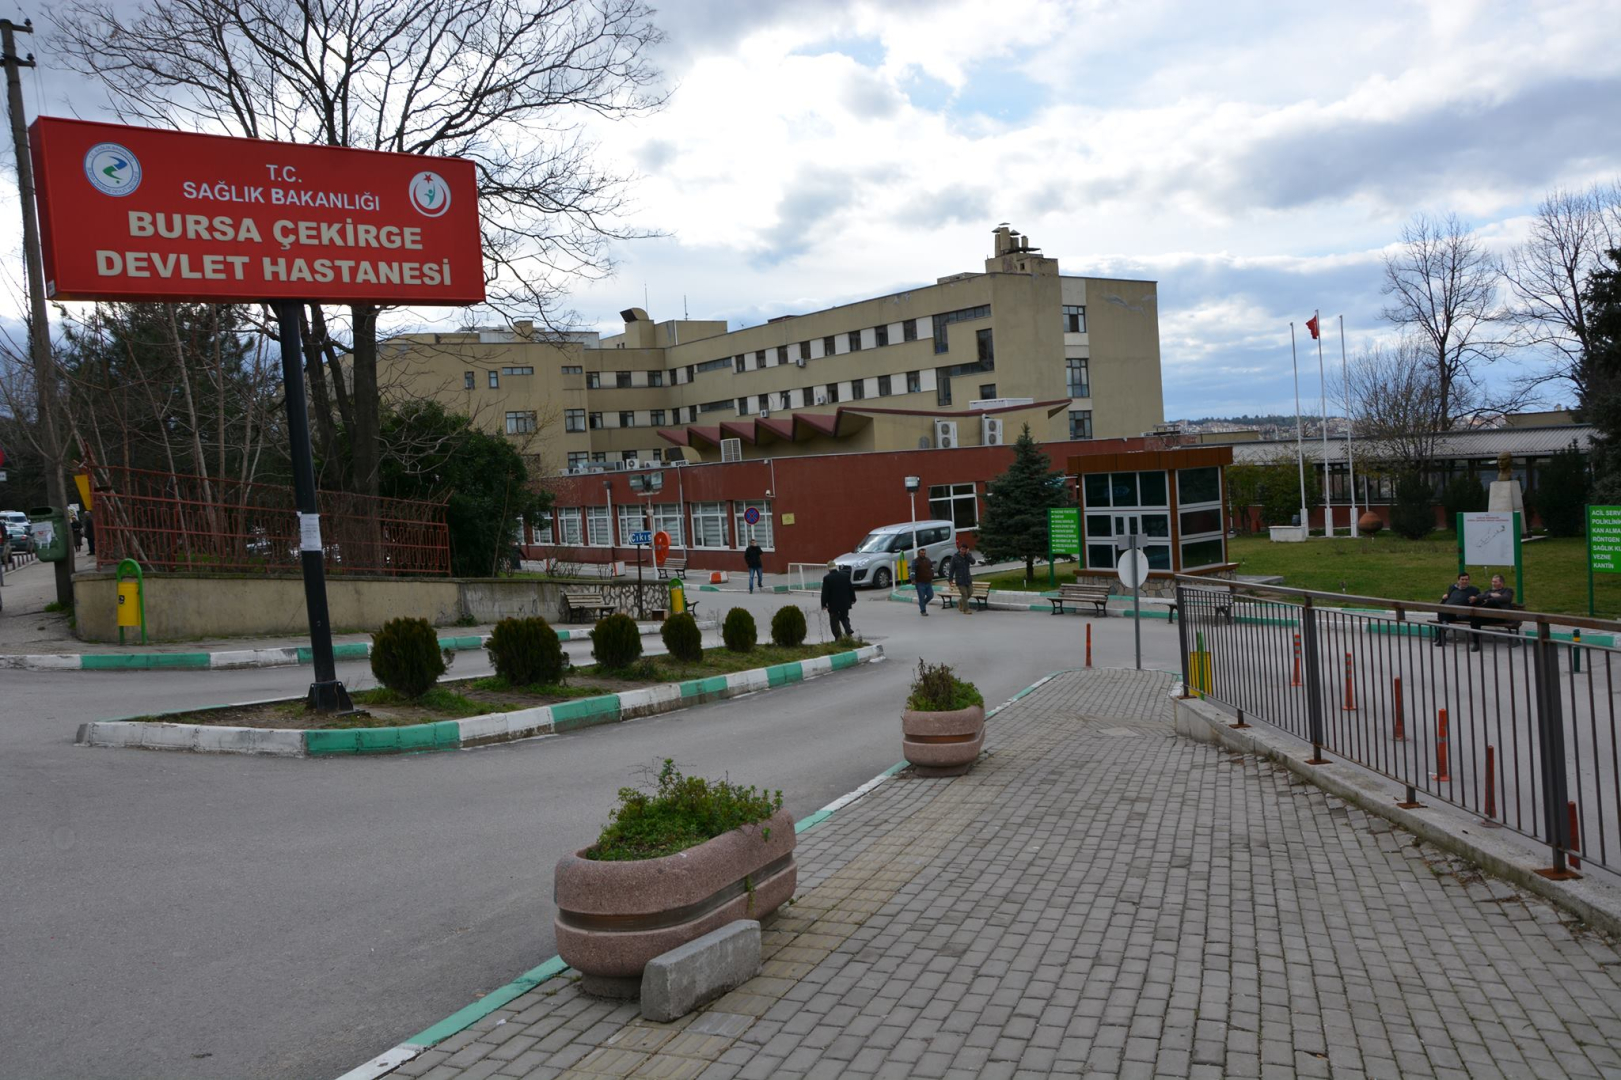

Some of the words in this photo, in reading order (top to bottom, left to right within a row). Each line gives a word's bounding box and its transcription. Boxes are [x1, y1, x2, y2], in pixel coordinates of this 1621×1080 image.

[266, 164, 302, 183] T.C.
[183, 180, 265, 204] SAĞLIK
[271, 188, 380, 211] BAKANLIĞI
[128, 211, 263, 242] BURSA
[272, 218, 423, 250] ÇEKİRGE
[96, 249, 249, 280] DEVLET
[262, 258, 451, 286] HASTANESİ
